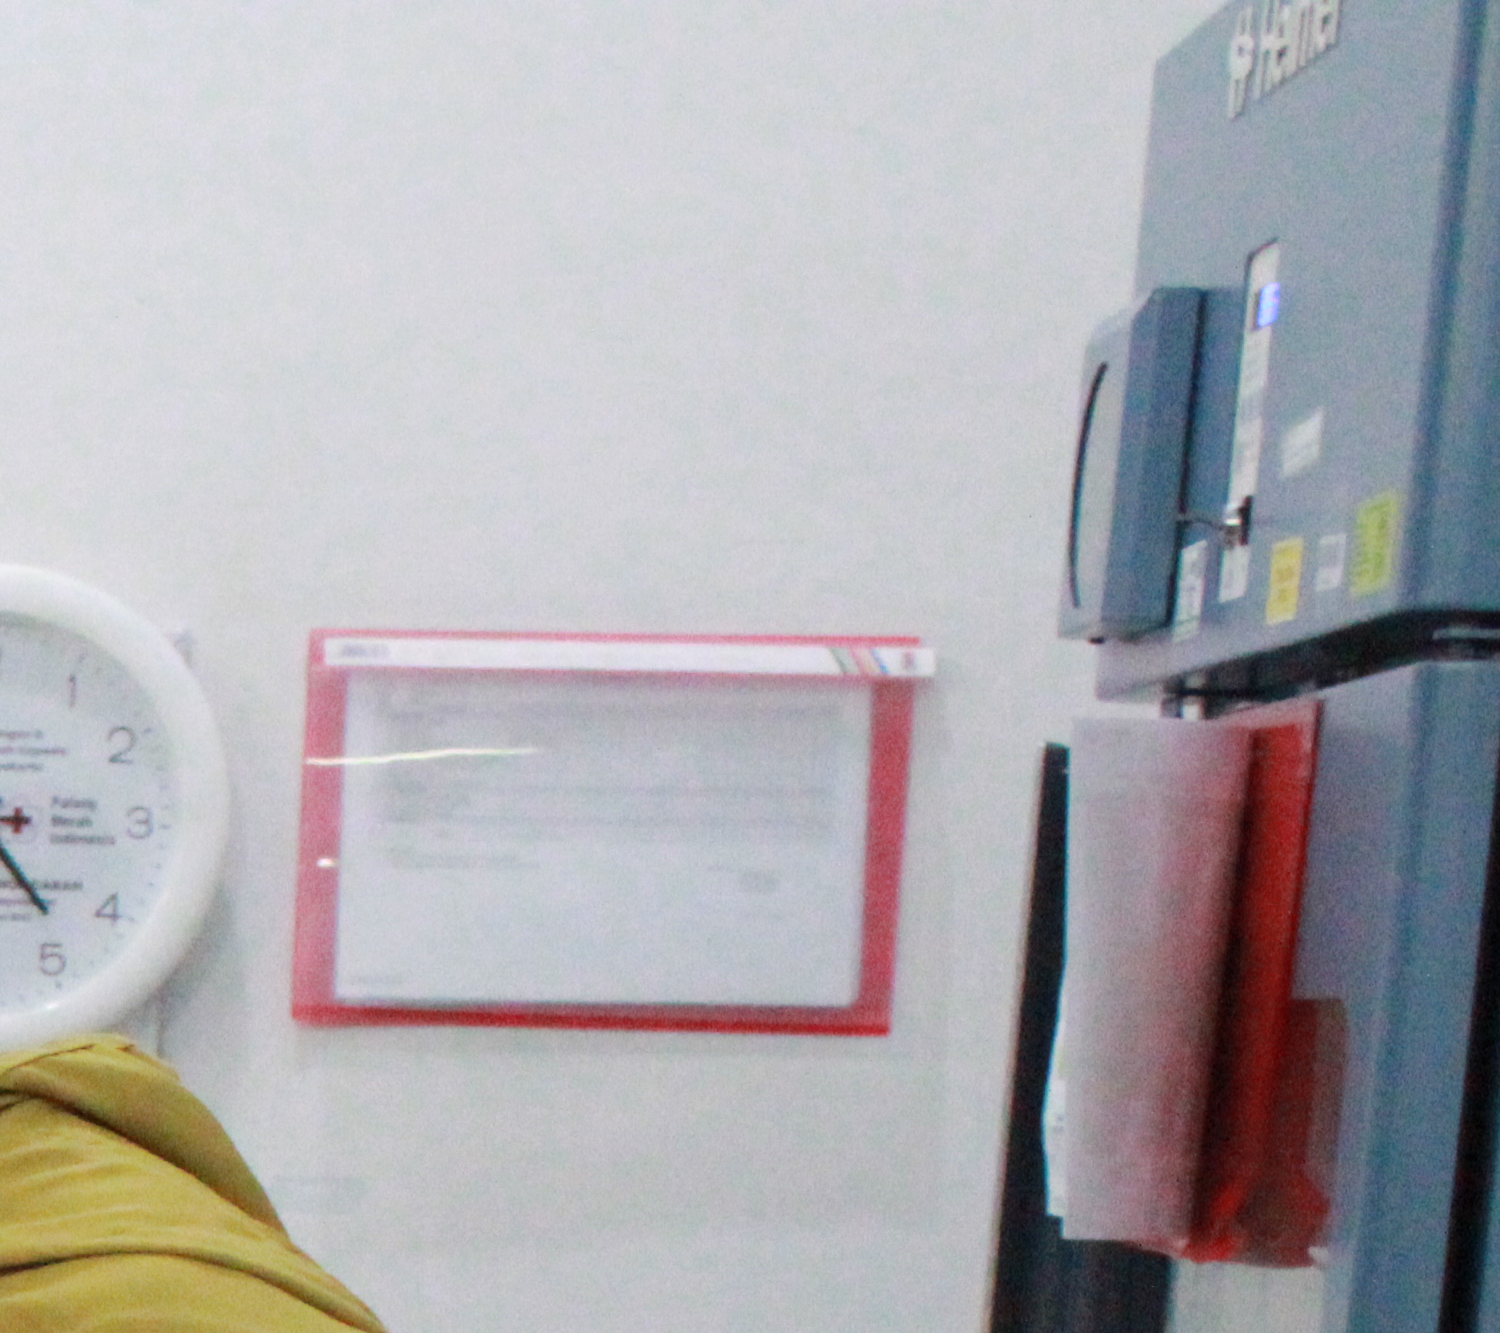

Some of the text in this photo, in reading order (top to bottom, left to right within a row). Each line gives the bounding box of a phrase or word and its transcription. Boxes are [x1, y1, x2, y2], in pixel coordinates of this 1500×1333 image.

[67, 674, 76, 708] 1
[107, 726, 136, 764] 2
[126, 807, 153, 839] 3
[95, 892, 123, 928] 4
[39, 943, 66, 976] 5
